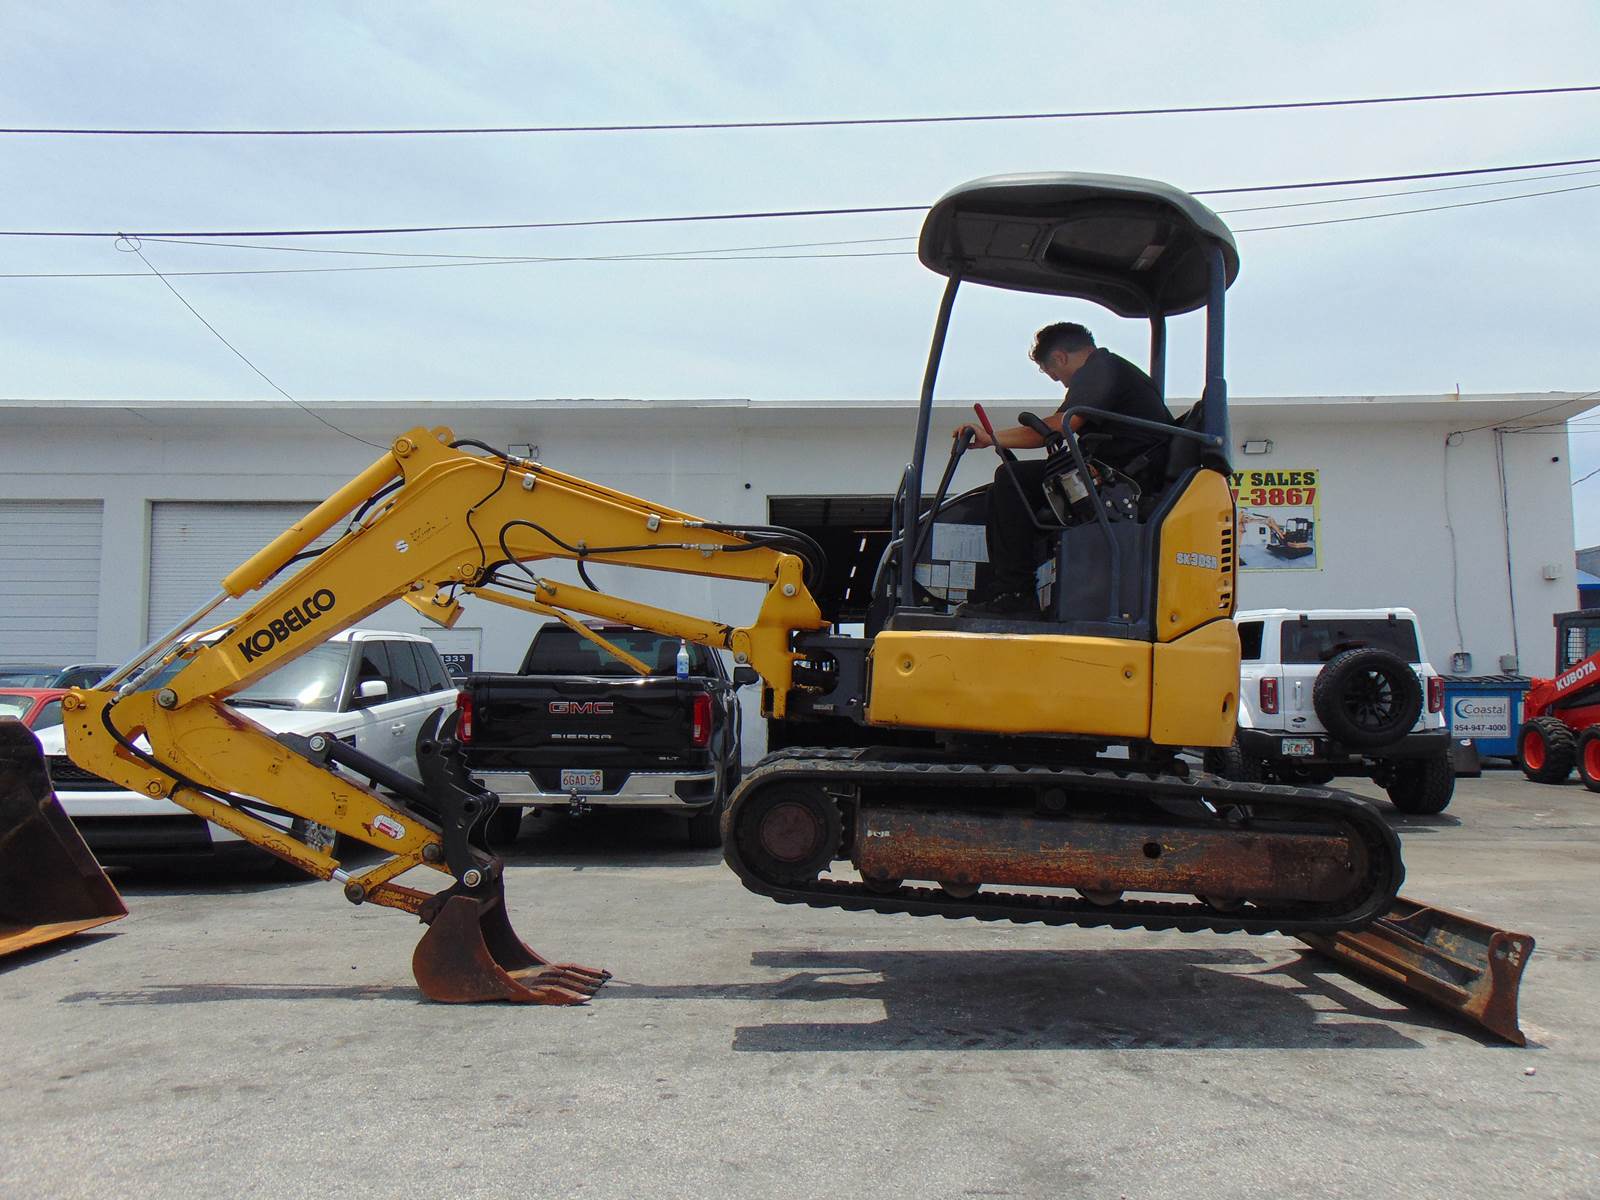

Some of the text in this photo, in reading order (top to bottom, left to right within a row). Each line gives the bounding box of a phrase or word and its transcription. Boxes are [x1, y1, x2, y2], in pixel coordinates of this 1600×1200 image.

[1250, 472, 1316, 487] SALES
[237, 588, 336, 663] KOBELCO
[1556, 661, 1597, 691] KUBOTA
[548, 701, 614, 714] GMC
[1463, 704, 1507, 714] Coastal
[1454, 724, 1507, 732] 954-947-4000
